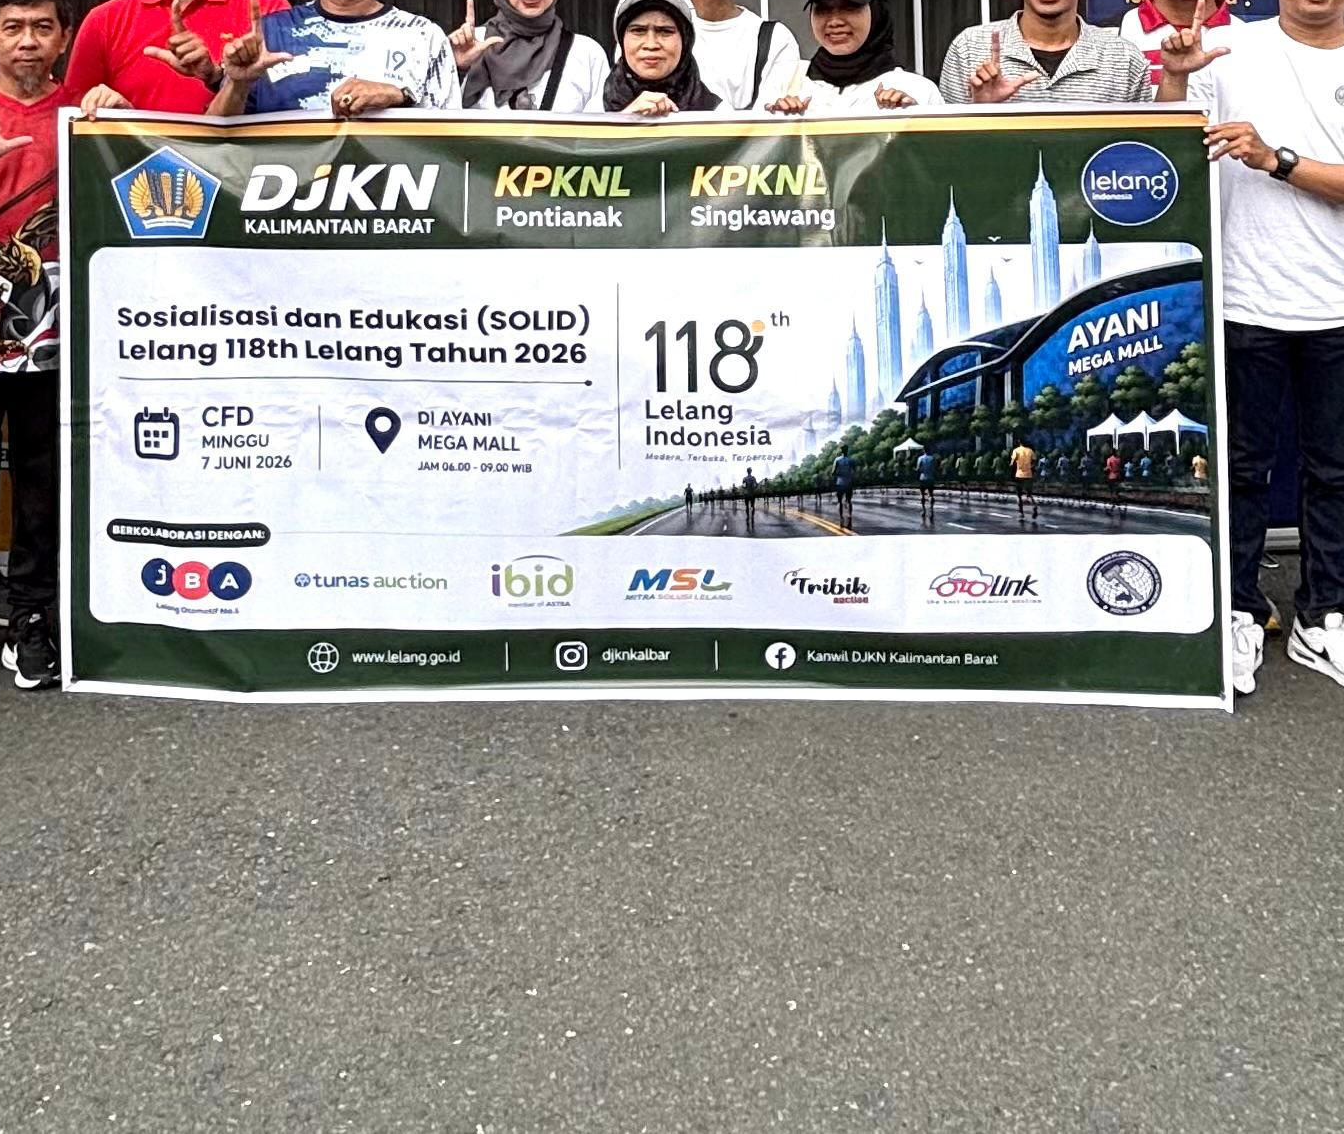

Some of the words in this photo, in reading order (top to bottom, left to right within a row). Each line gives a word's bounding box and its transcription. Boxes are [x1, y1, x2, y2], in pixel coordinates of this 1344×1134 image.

[494, 165, 631, 198] KPKNL
[690, 164, 828, 197] KPKNL
[1090, 170, 1170, 200] lelang
[244, 218, 367, 235] KALIMANTAN
[373, 218, 435, 234] BARAT
[496, 206, 623, 228] Pontianak
[690, 205, 836, 231] Singkawang
[117, 304, 278, 328] Sosialisasi
[285, 306, 342, 329] dan
[349, 307, 468, 331] Edukasi
[477, 304, 591, 335] (SOLID)
[770, 310, 791, 327] th
[1067, 299, 1160, 354] AYANI
[118, 339, 218, 365] Lelang
[226, 337, 298, 361] 118th
[305, 340, 402, 367] Lelang
[410, 341, 507, 364] Tahun
[514, 342, 587, 365] 2026
[1067, 348, 1116, 377] MEGA
[1116, 336, 1164, 366] MALL
[201, 406, 254, 427] CFD
[418, 411, 435, 425] DI
[442, 412, 492, 427] AYANI
[645, 399, 734, 425] Lelang
[201, 434, 270, 448] MINGGU
[418, 435, 468, 450] MEGA
[473, 436, 521, 451] MALL
[645, 425, 772, 447] Indonesia
[201, 456, 210, 469] 7
[214, 456, 251, 469] JUNI
[256, 455, 293, 469] 2026
[418, 461, 440, 472] JAM
[442, 462, 471, 472] 06.00
[480, 462, 509, 473] 09.00
[513, 463, 532, 473] WIB
[112, 525, 206, 540] BERKOLABORASI
[313, 573, 370, 588] tunas
[373, 573, 448, 590] auction
[491, 563, 574, 597] ibid
[628, 569, 733, 591] MSL
[790, 576, 871, 596] Tribik
[352, 649, 461, 665] www.lelang.go.id
[602, 648, 671, 664] djknkalbar
[807, 649, 849, 662] Kanwil
[852, 651, 886, 663] DJKN
[890, 651, 961, 664] Kalimantan
[964, 653, 999, 665] Barat
